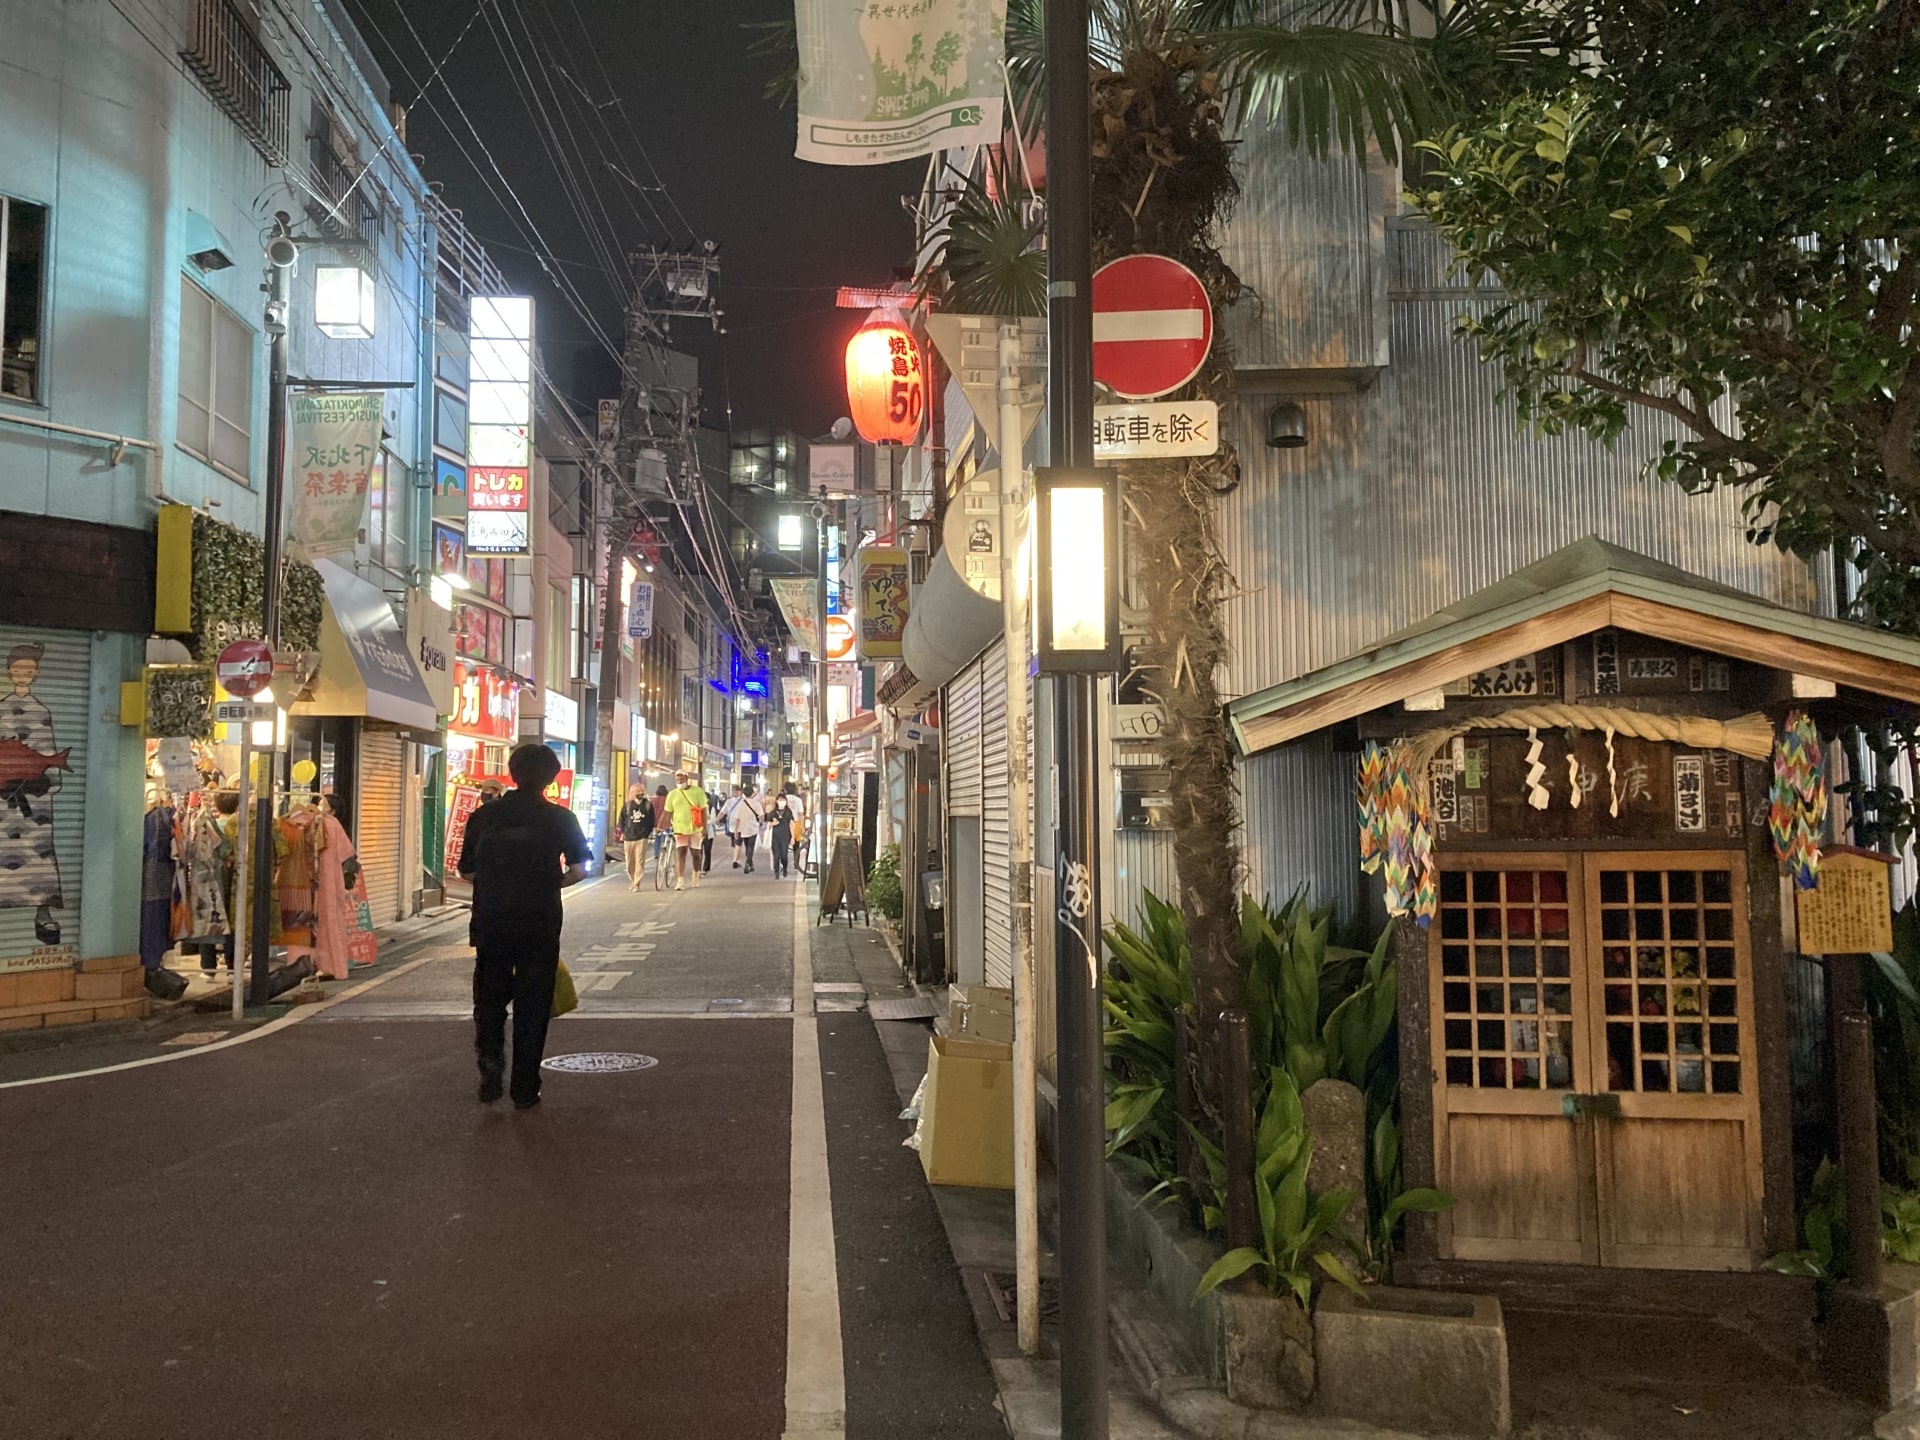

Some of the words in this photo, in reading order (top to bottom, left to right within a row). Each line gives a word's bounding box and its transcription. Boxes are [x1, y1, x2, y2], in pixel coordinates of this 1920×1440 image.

[889, 335, 909, 377] 焼鳥
[890, 380, 921, 426] 50
[473, 472, 524, 491] トレカ
[472, 492, 524, 507] 買います
[219, 706, 271, 719] 自転車を除く
[446, 793, 474, 872] 買取強化中
